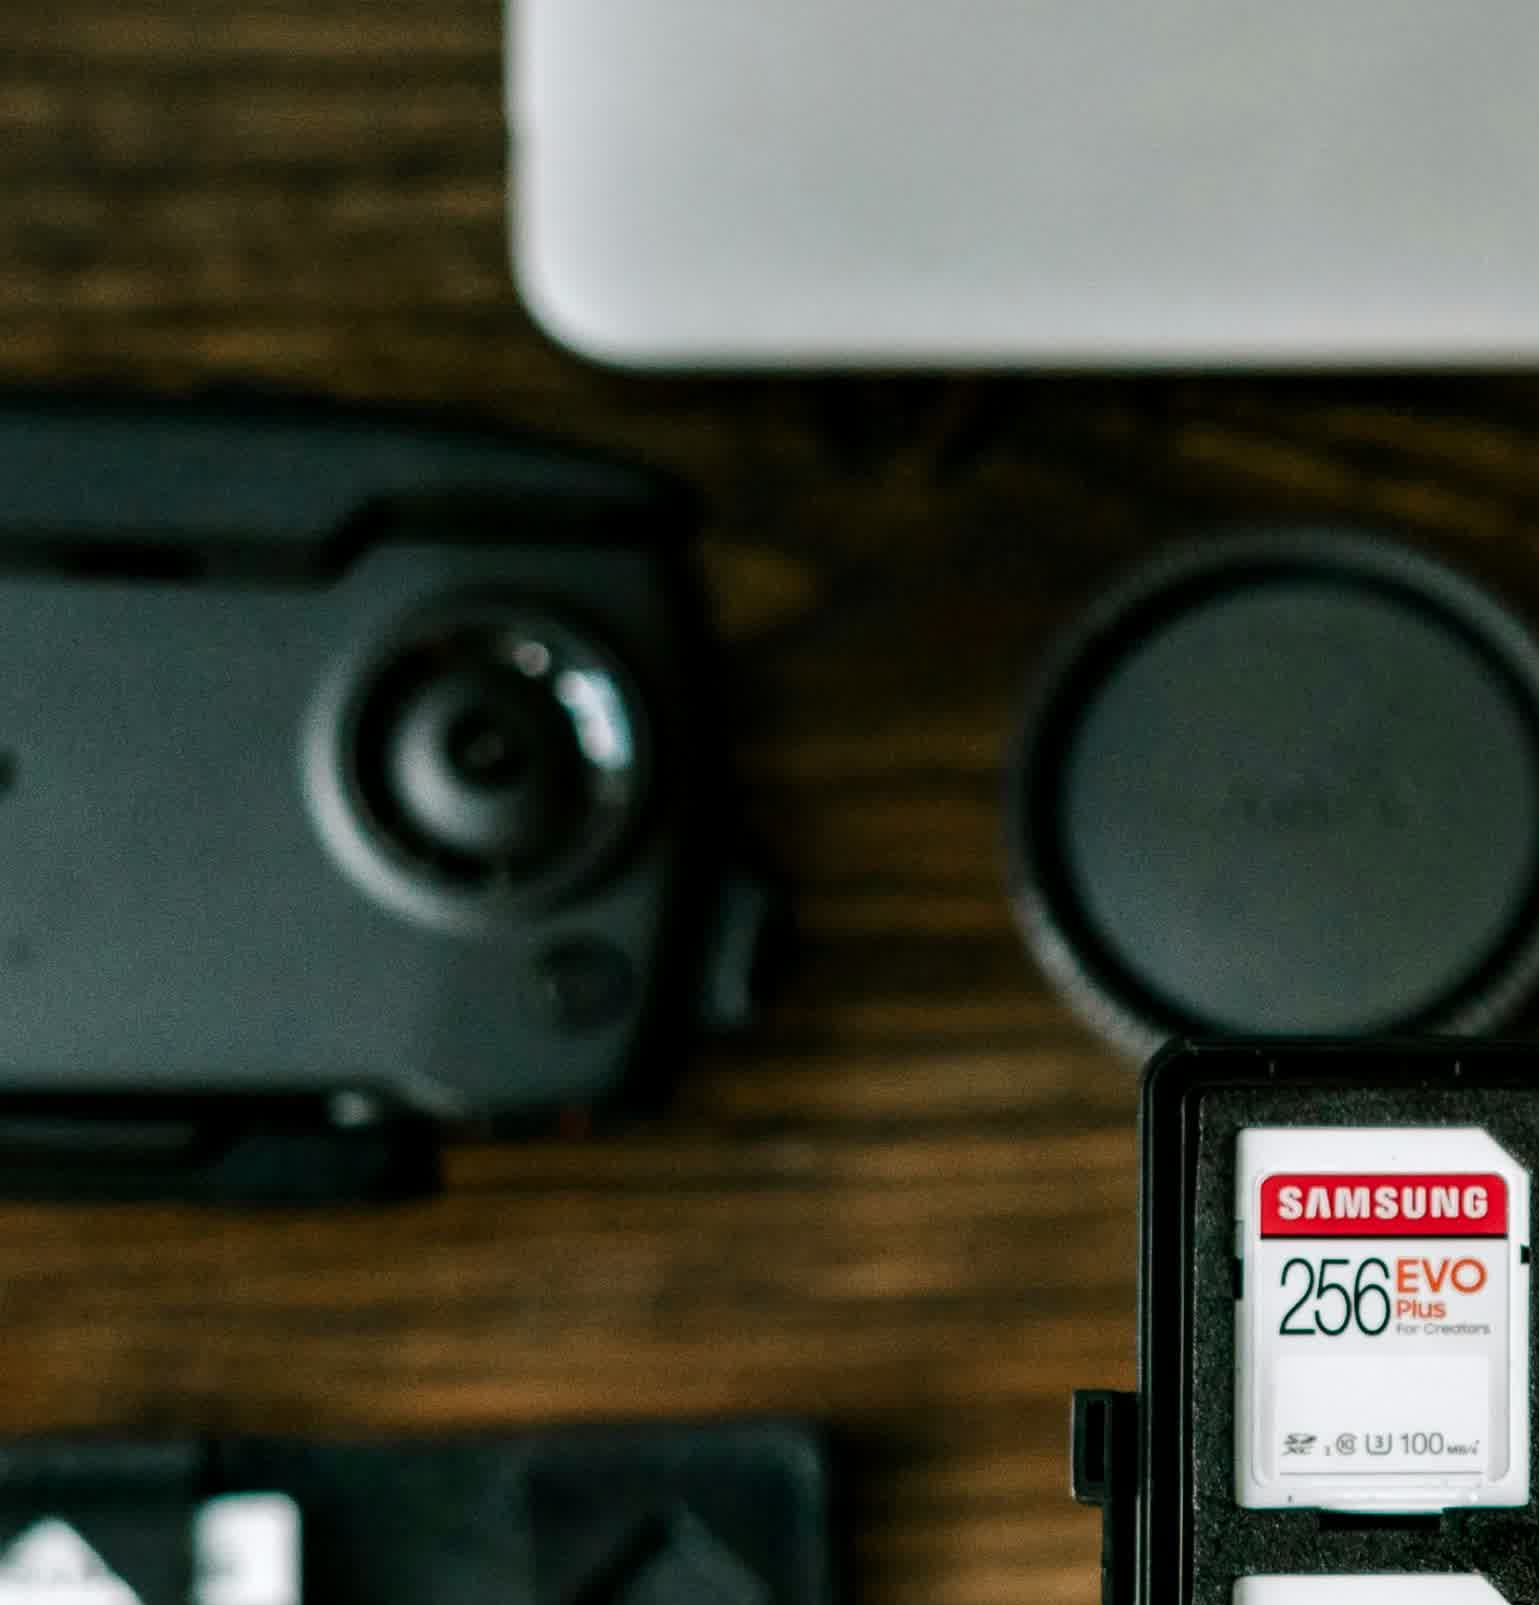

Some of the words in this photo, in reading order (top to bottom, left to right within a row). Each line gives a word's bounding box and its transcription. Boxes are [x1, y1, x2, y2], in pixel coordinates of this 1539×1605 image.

[1277, 1186, 1488, 1220] SAMSUNG
[1280, 1257, 1391, 1336] 256
[1396, 1259, 1487, 1293] EVO
[1396, 1300, 1446, 1318] Plus
[1401, 1432, 1444, 1455] 100
